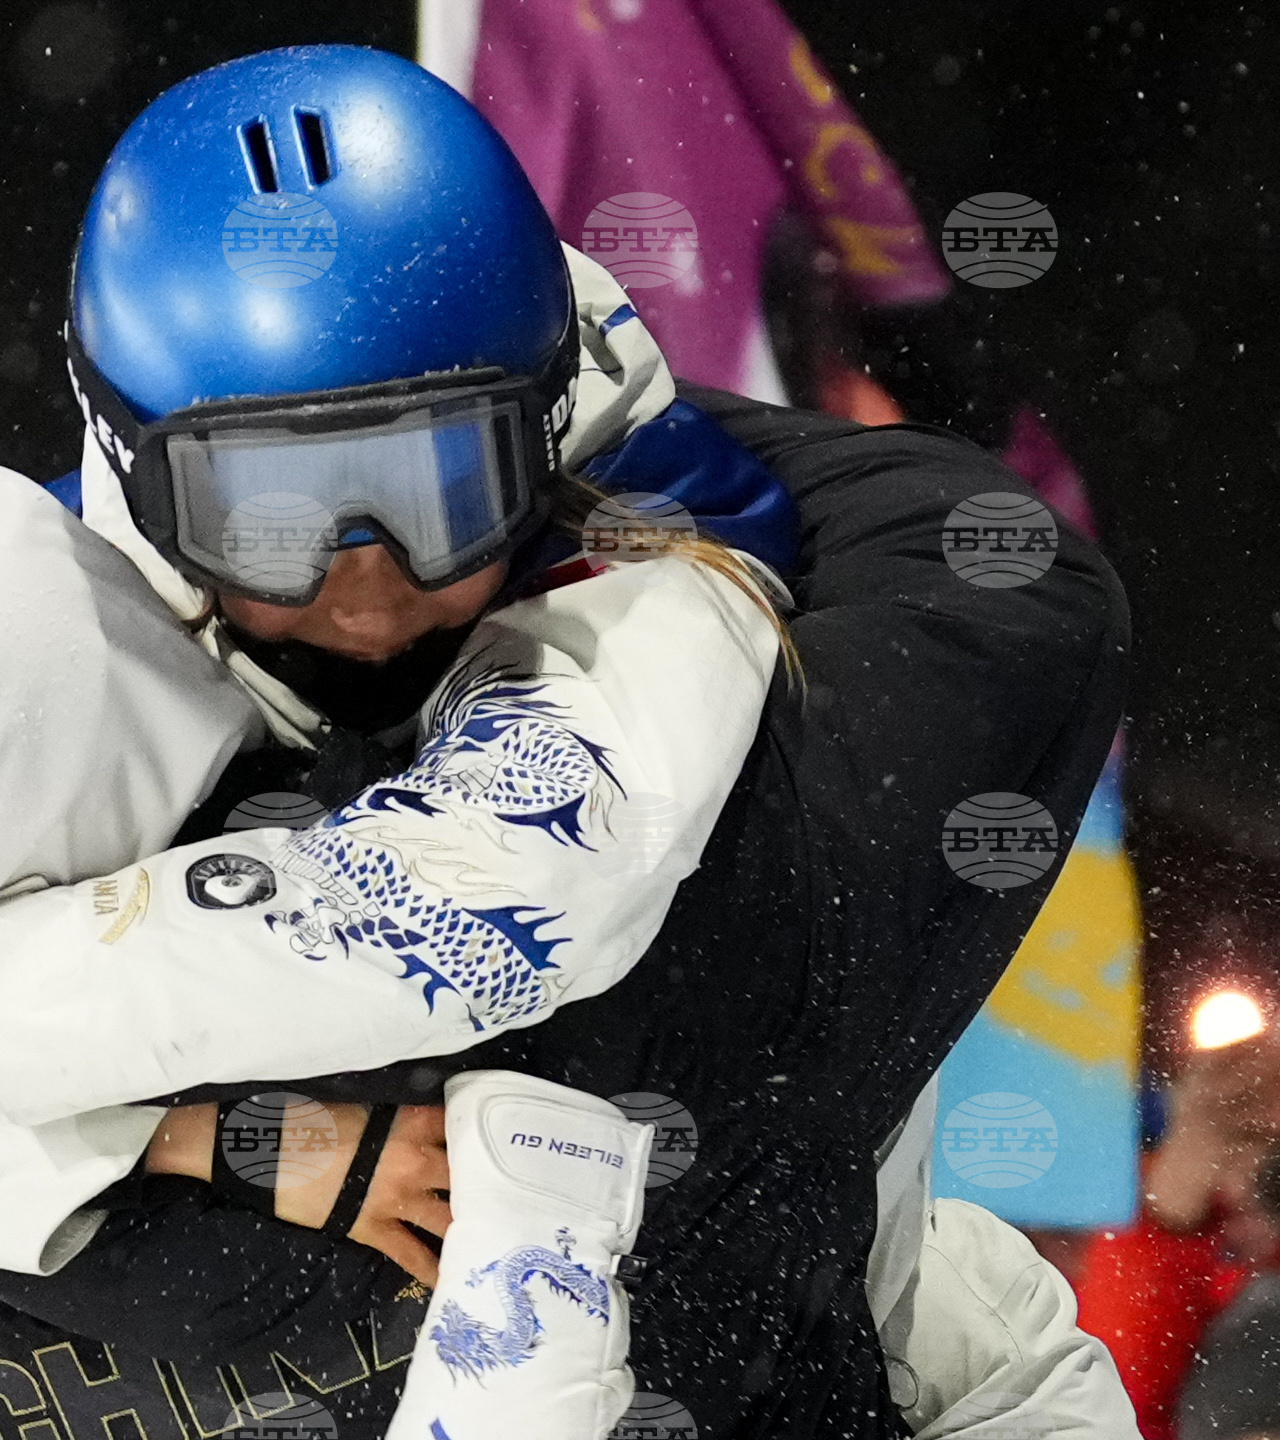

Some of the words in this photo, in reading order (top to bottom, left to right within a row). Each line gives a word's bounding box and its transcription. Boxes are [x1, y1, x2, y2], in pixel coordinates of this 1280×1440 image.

[93, 880, 119, 916] ANTA
[511, 1133, 542, 1148] GU
[549, 1138, 624, 1169] EILEEN
